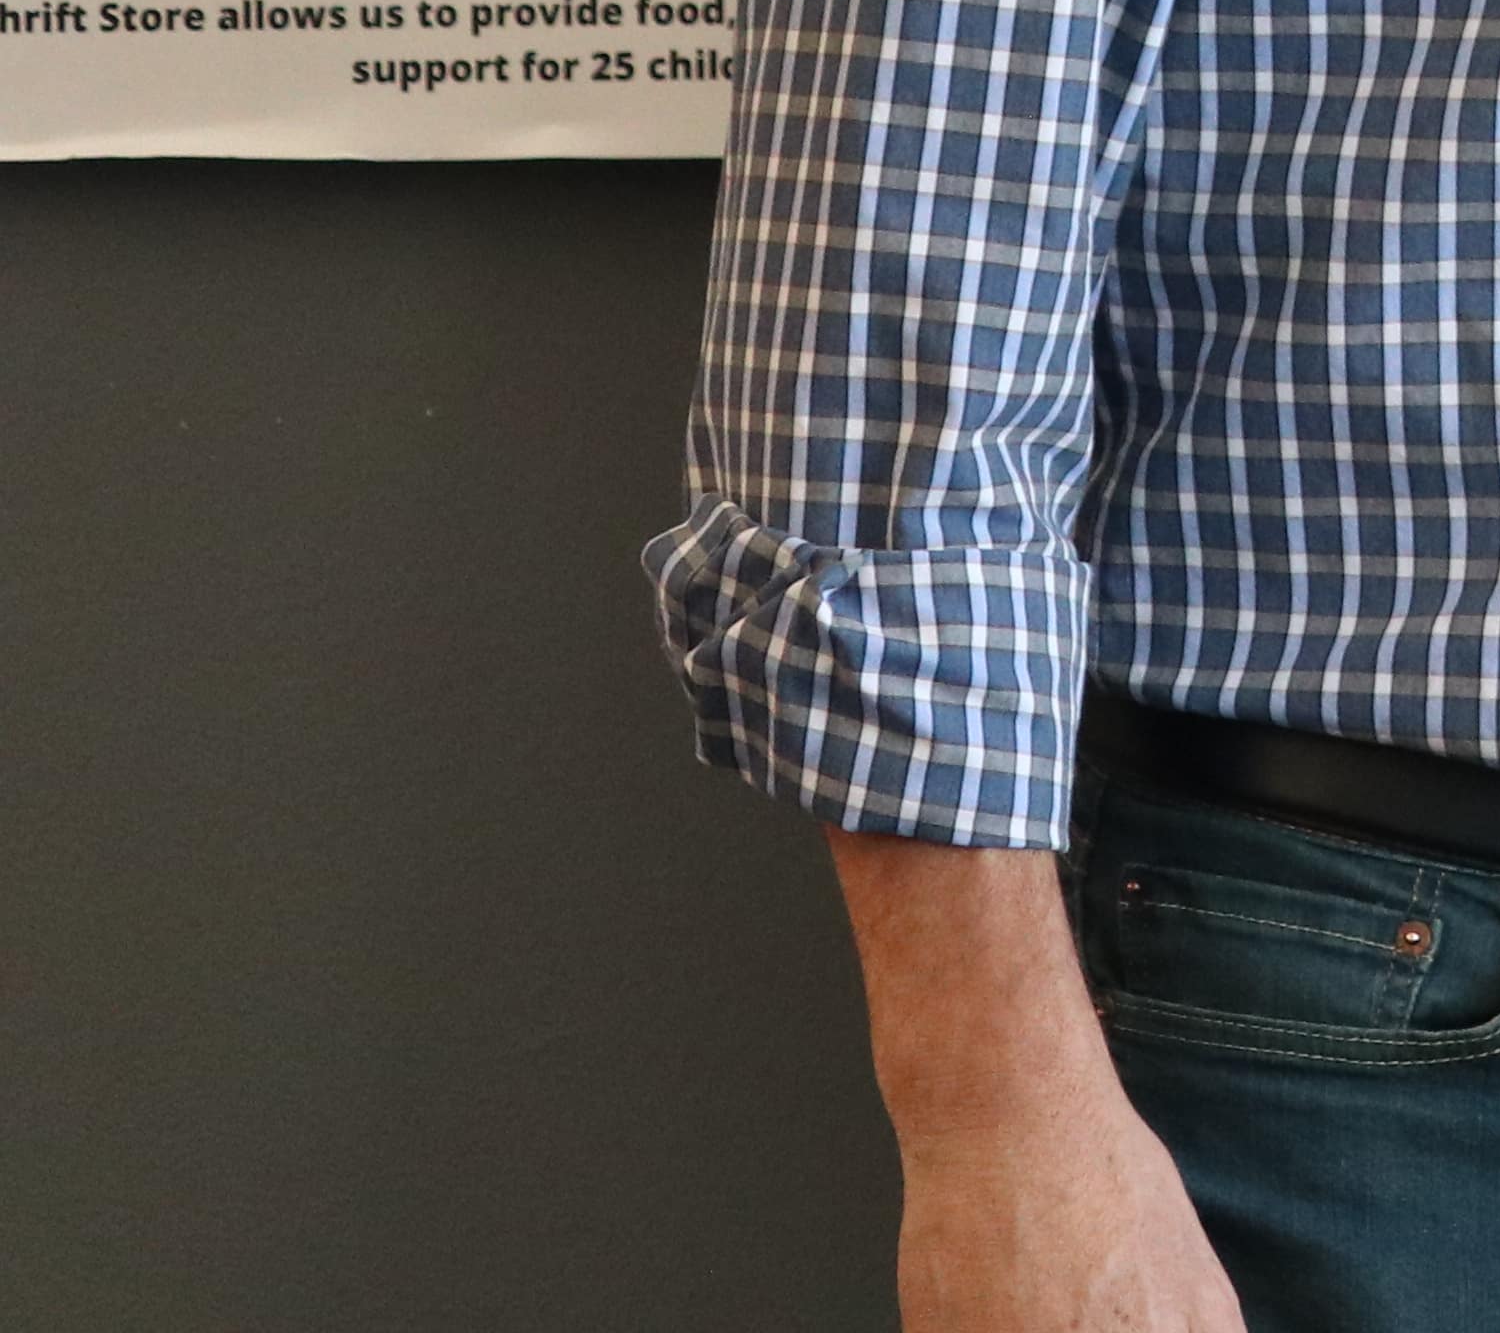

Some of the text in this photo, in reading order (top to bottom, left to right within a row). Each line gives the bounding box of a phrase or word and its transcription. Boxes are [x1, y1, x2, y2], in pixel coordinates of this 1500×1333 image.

[99, 2, 205, 33] Store
[217, 0, 347, 31] allows
[360, 5, 404, 29] us
[417, 1, 458, 28] to
[352, 55, 510, 93] support
[521, 50, 580, 82] for
[591, 51, 635, 82] 25
